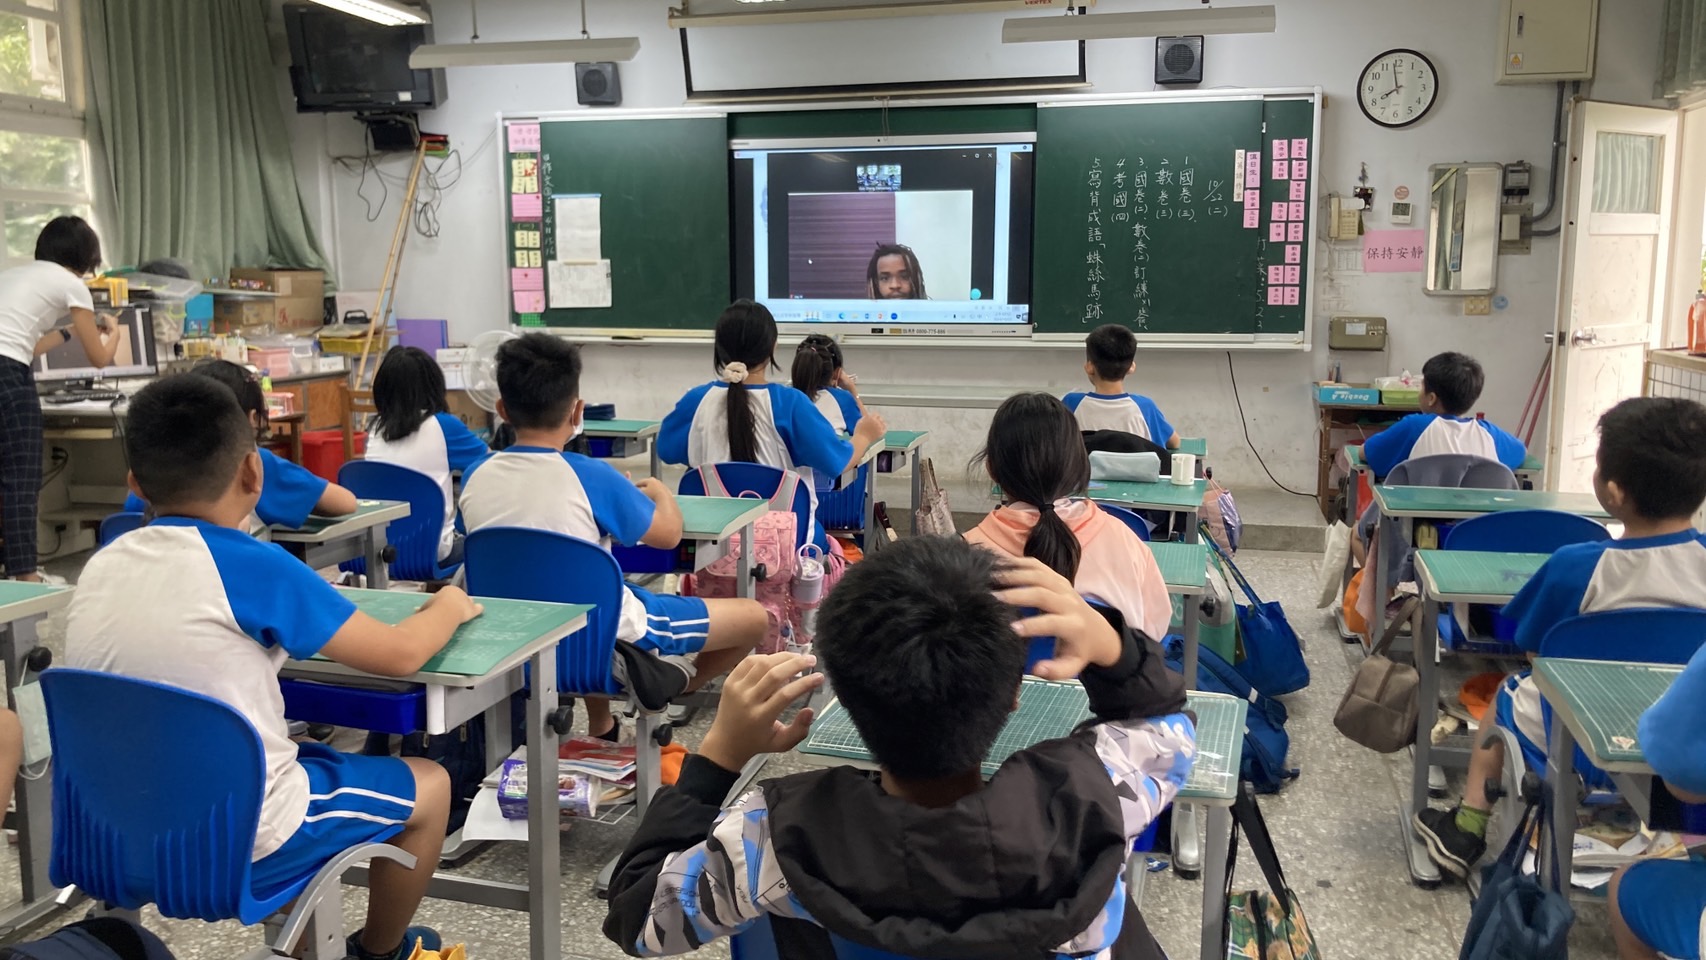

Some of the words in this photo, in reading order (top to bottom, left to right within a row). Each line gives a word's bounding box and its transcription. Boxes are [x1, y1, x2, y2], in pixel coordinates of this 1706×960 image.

[1381, 63, 1389, 71] 11
[1371, 72, 1381, 81] 10
[1417, 70, 1424, 79] 2
[1368, 85, 1374, 94] 9
[1420, 84, 1426, 92] 3
[1371, 98, 1377, 107] 8
[1416, 96, 1421, 105] 4
[1380, 107, 1386, 115] 7
[1392, 110, 1398, 119] 6
[1407, 106, 1413, 115] 5
[1366, 245, 1424, 260] 保持安靜
[1339, 393, 1370, 401] Double
